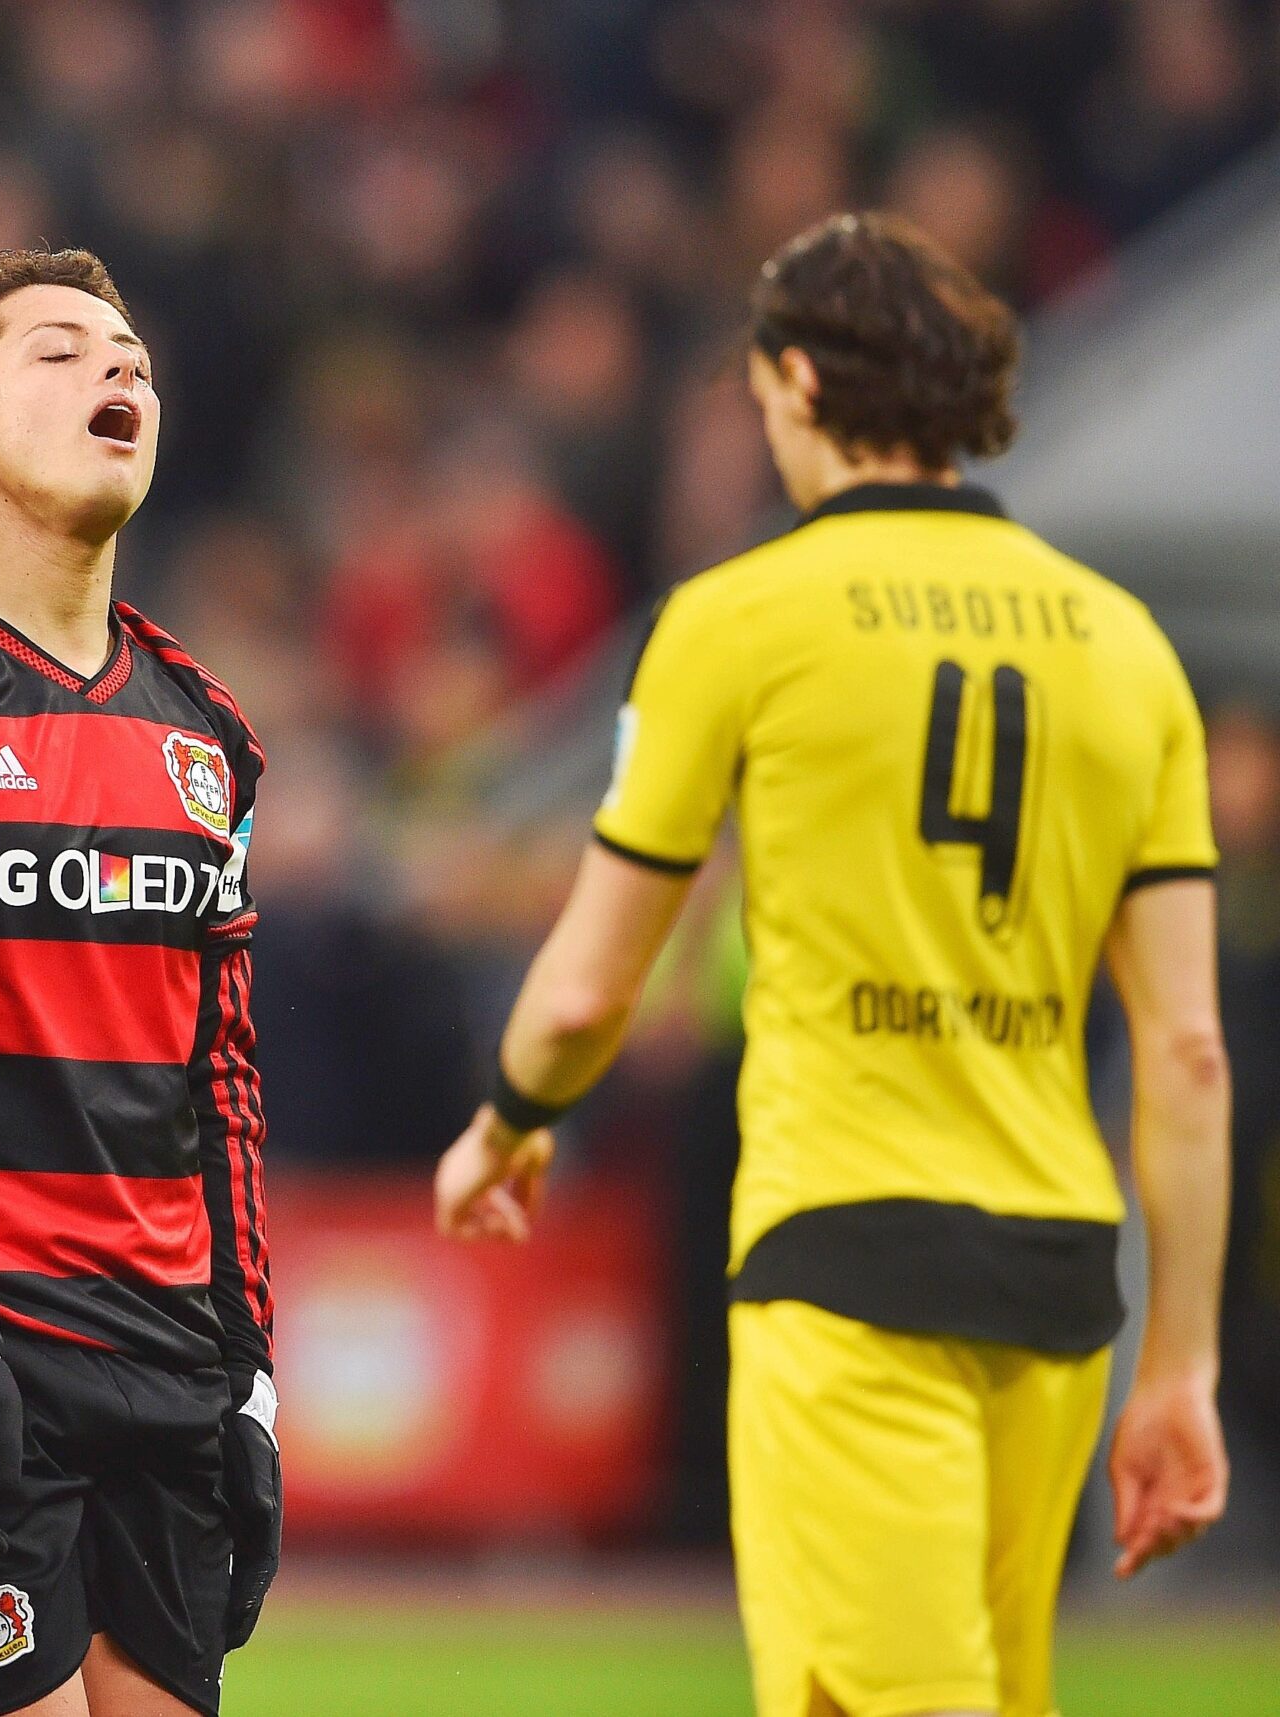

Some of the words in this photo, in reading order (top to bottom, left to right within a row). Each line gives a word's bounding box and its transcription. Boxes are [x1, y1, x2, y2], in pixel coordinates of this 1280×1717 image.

[847, 581, 1091, 642] SUBOTIC
[919, 659, 1026, 934] 4
[49, 849, 195, 914] OLED
